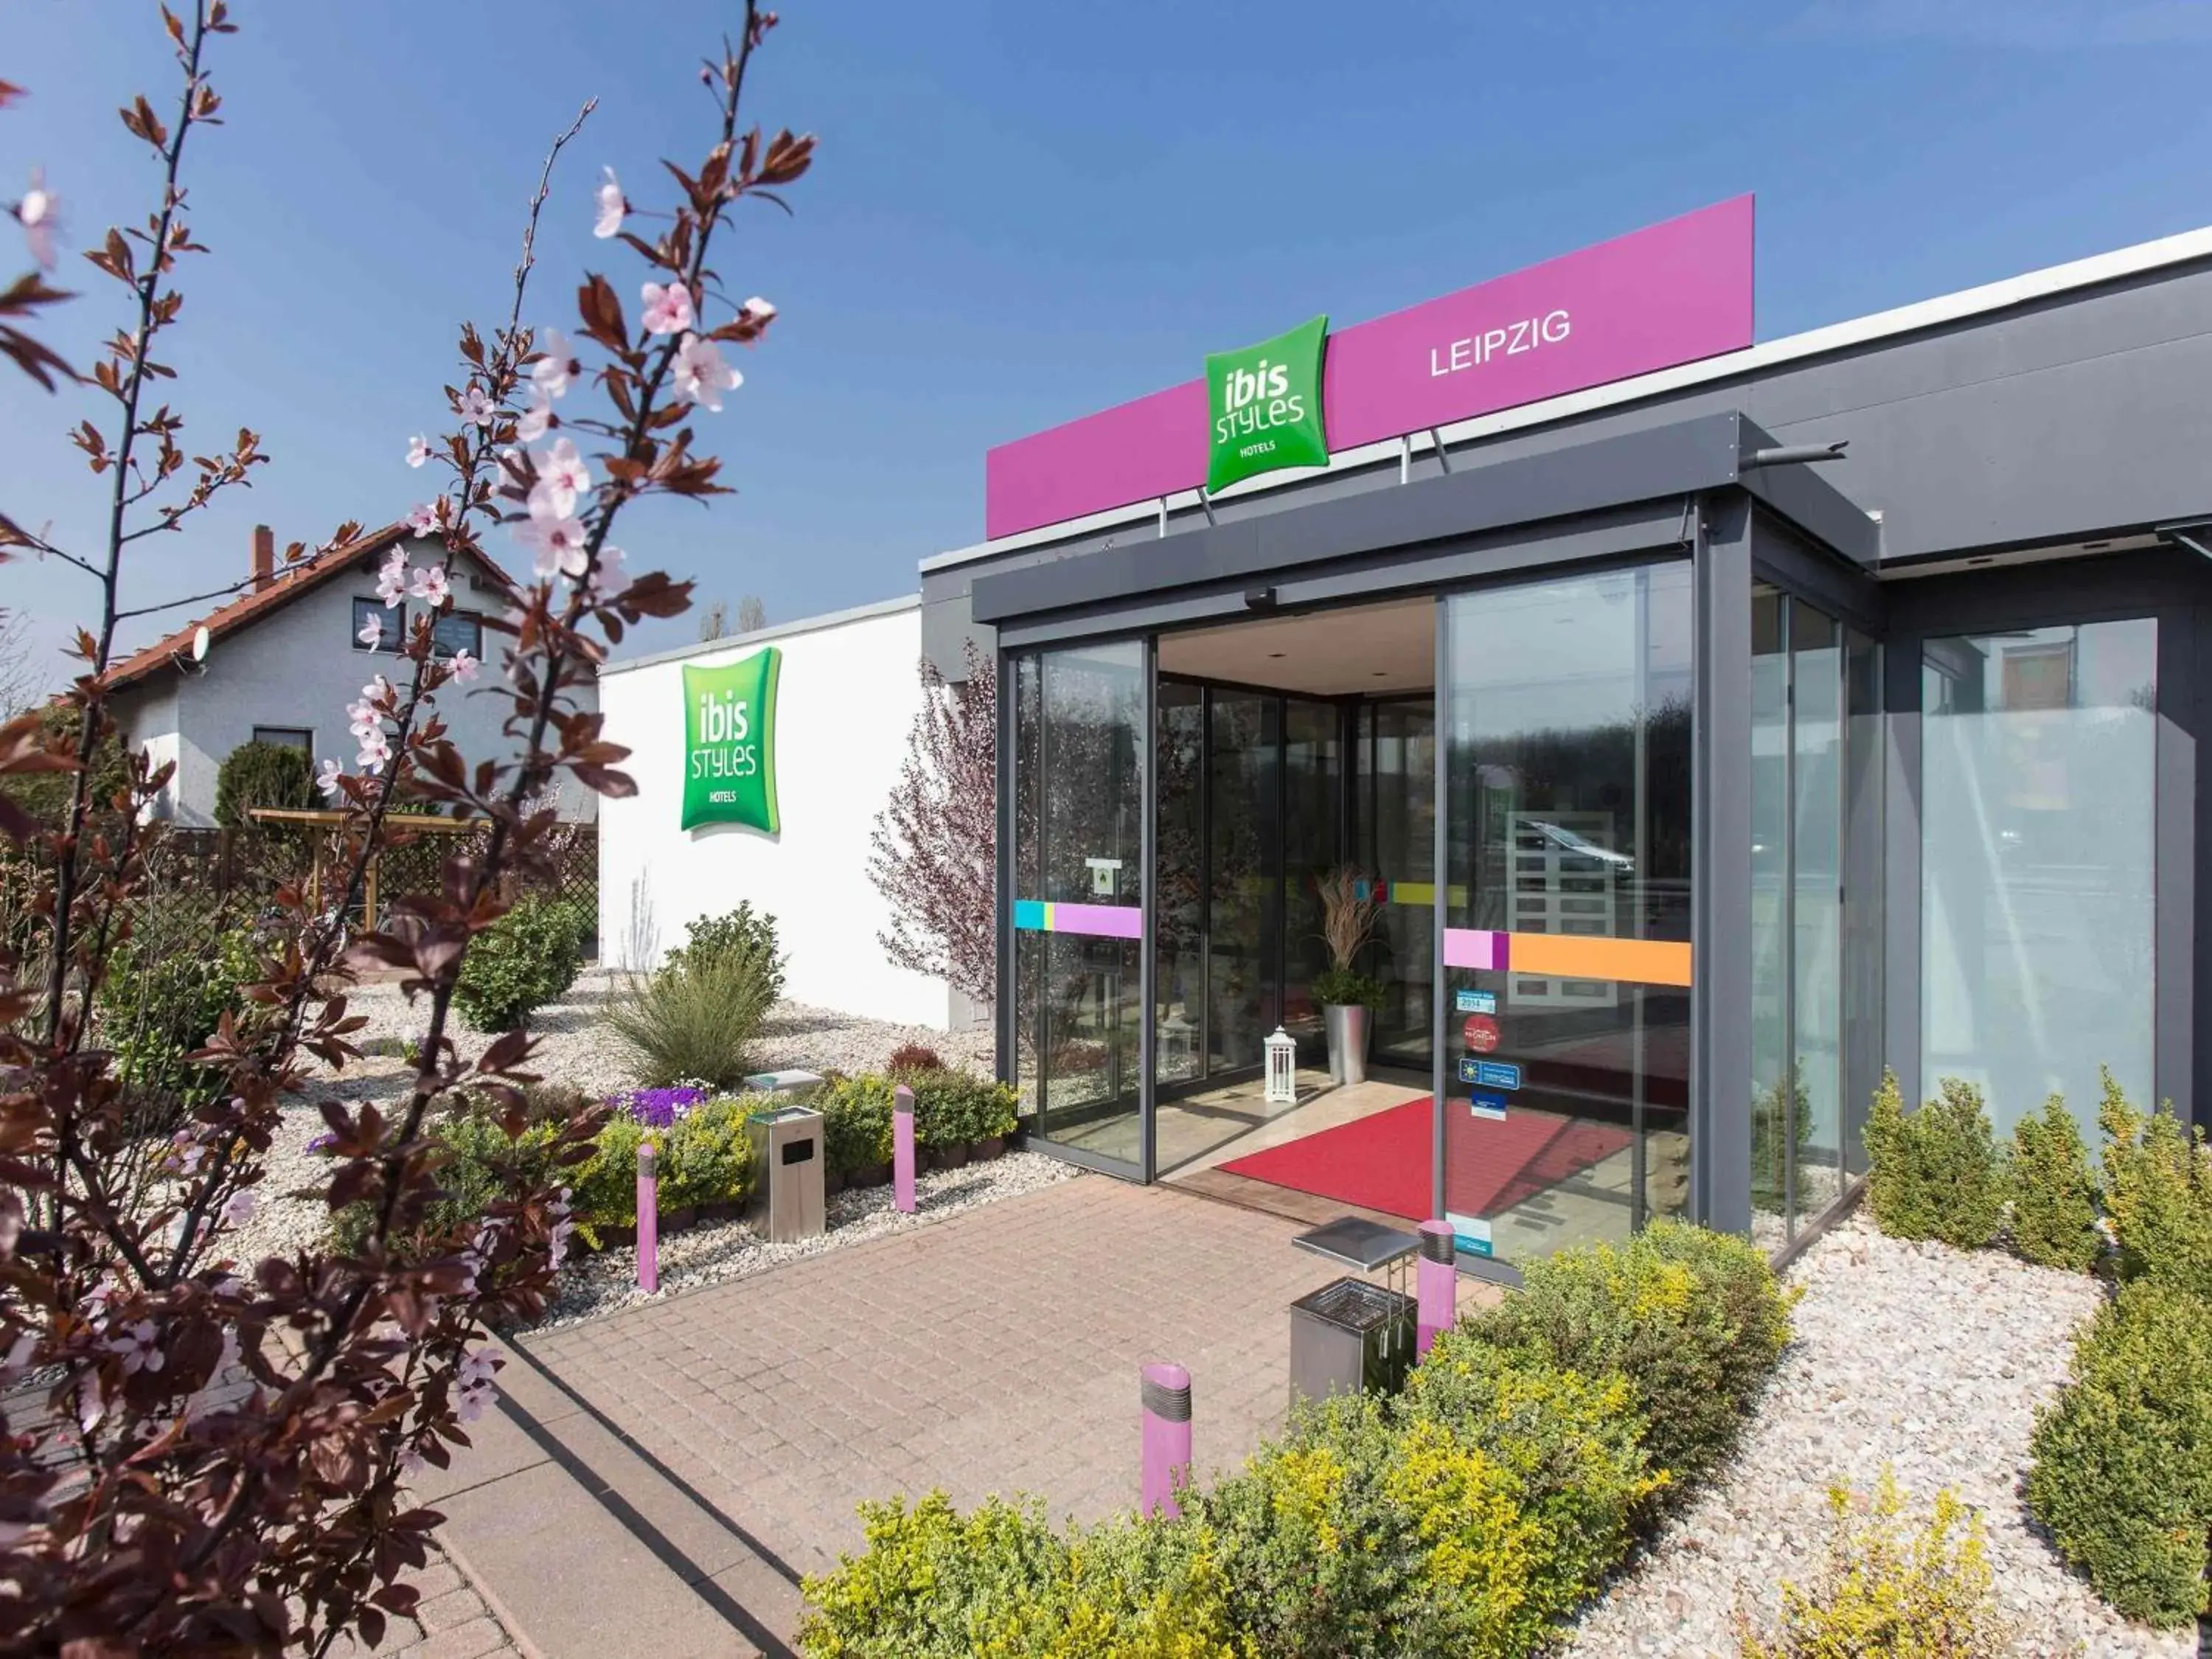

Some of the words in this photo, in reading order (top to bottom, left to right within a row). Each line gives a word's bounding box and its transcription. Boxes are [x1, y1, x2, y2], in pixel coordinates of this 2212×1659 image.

[1430, 309, 1571, 377] LEIPZIG
[1225, 358, 1289, 413] ibis
[1240, 439, 1276, 459] HOTELS
[700, 689, 748, 744] ibis
[709, 790, 737, 803] HOTELS
